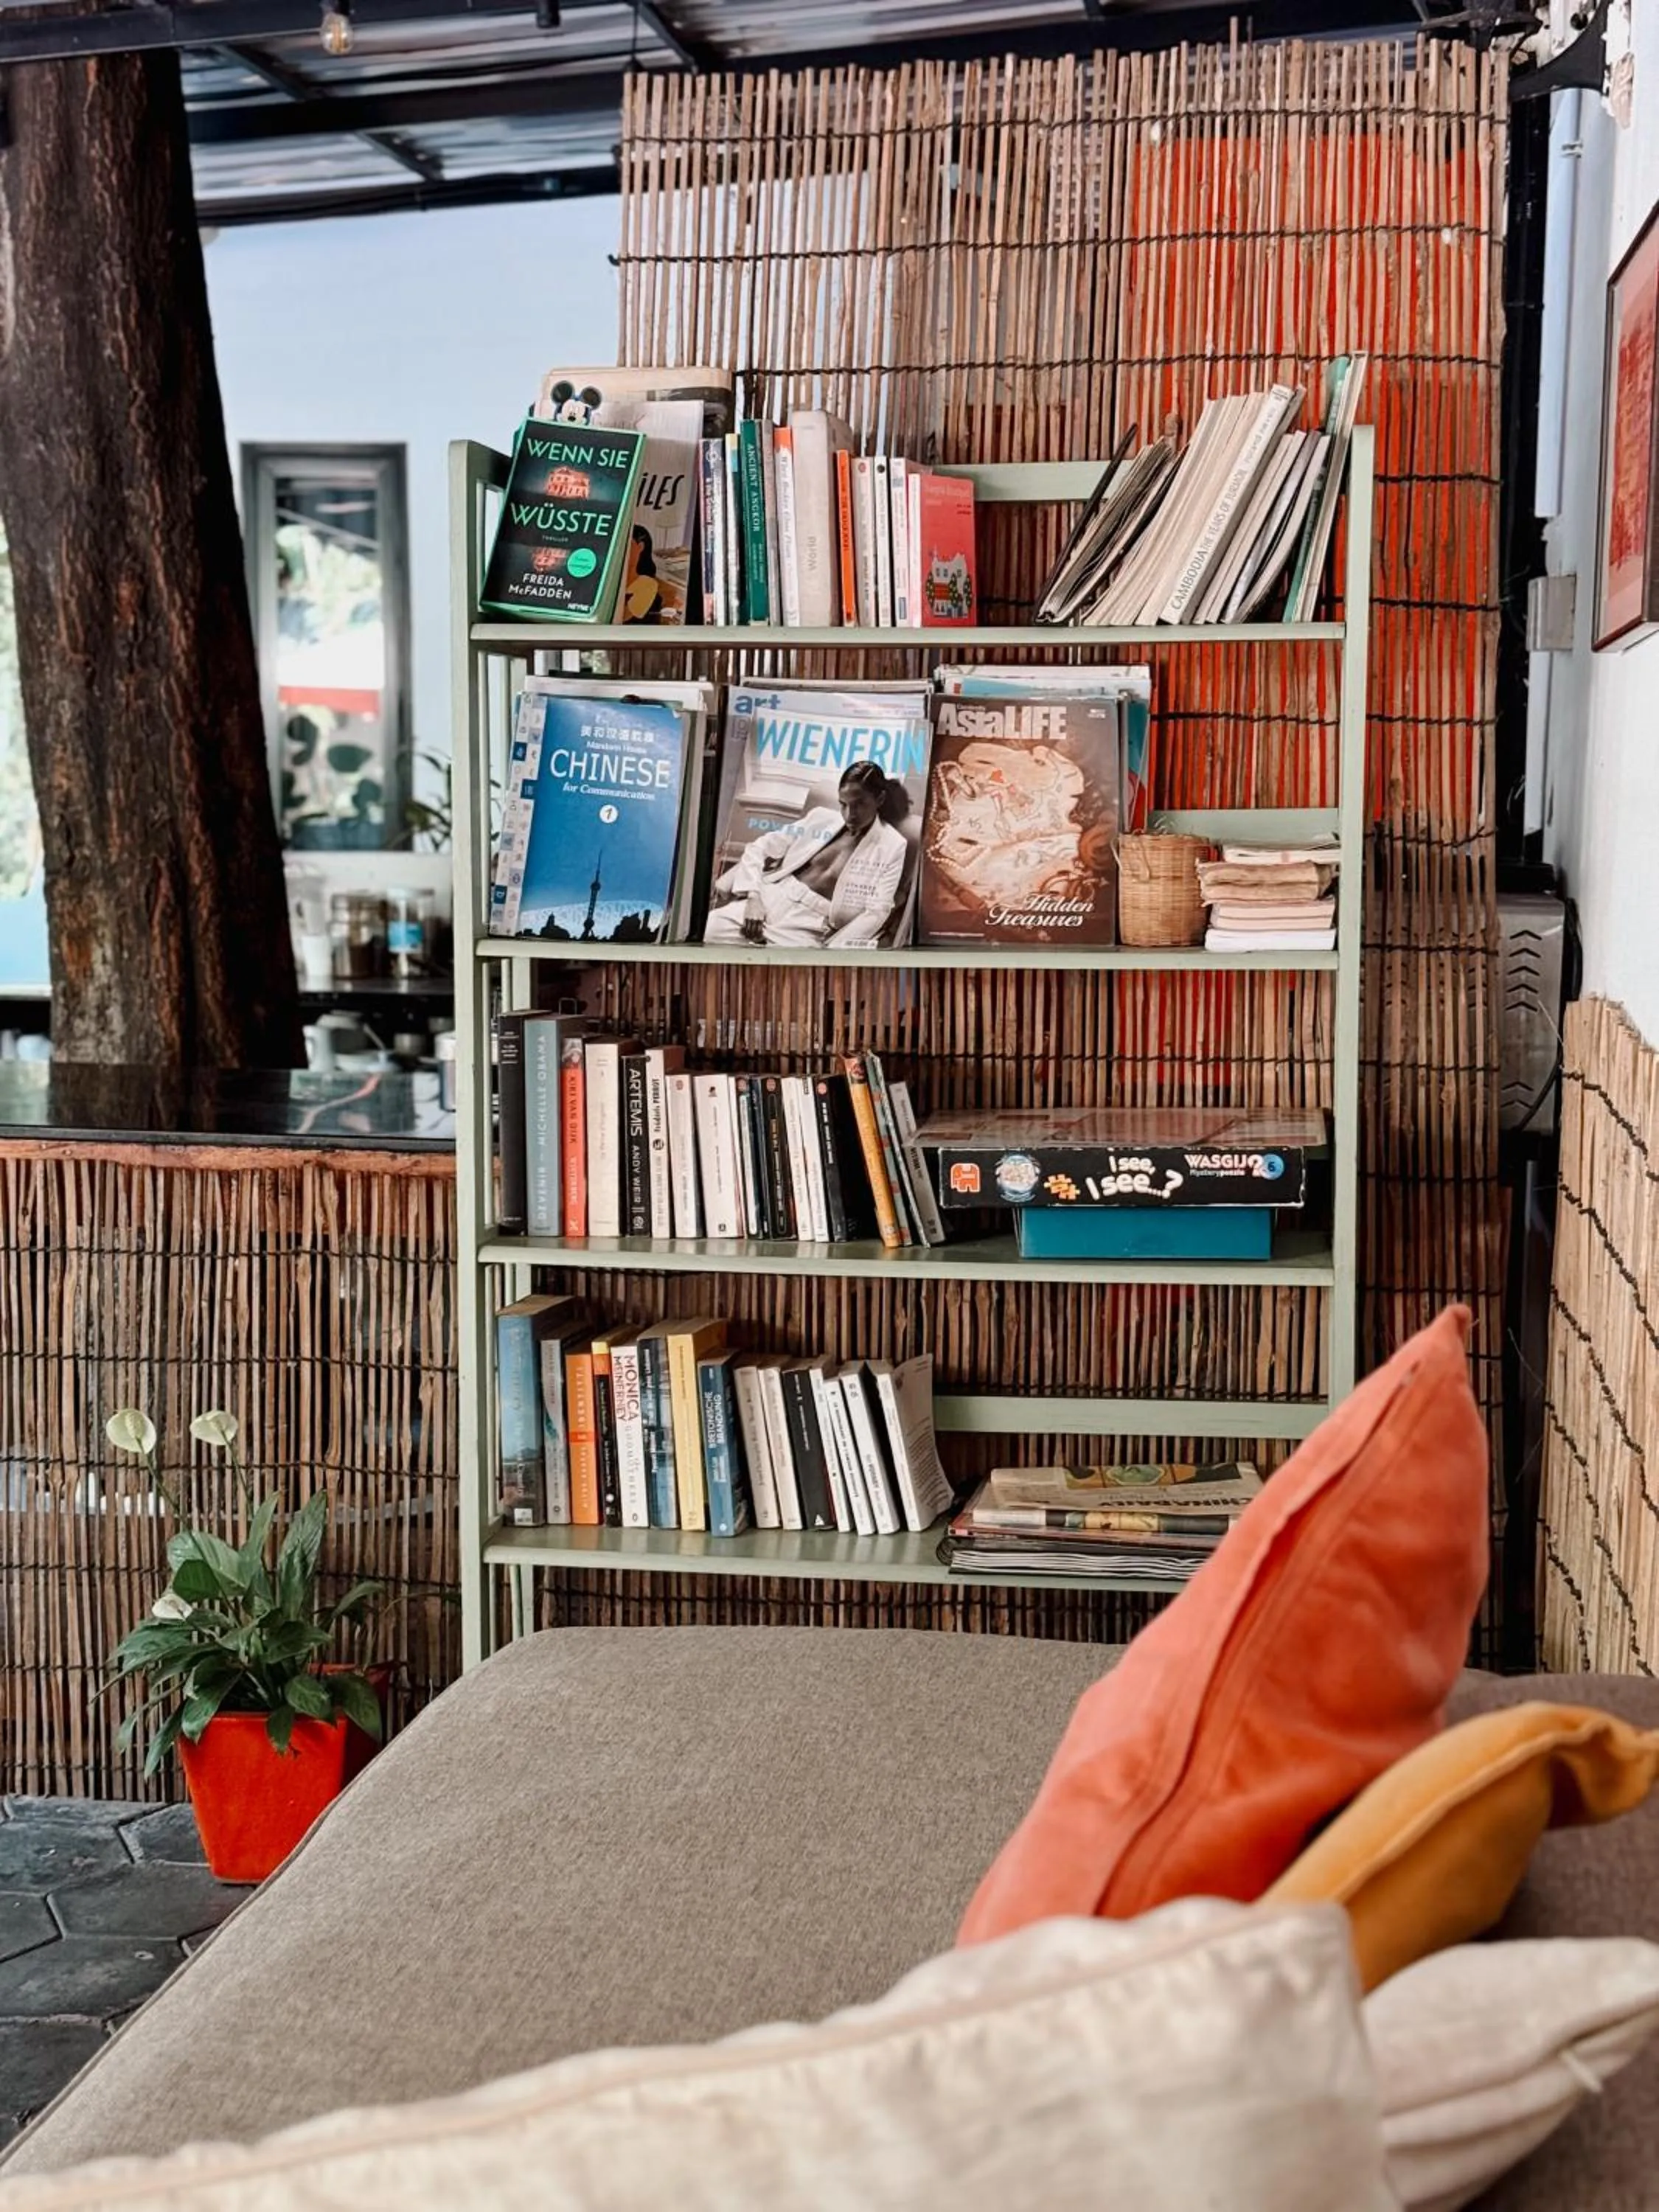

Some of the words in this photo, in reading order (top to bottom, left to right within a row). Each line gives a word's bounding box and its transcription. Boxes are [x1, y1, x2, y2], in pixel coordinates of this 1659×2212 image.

[526, 439, 593, 464] WENN
[597, 448, 630, 468] SIE
[746, 445, 758, 487] ANCIENT
[510, 502, 612, 536] WÜSSTE
[751, 490, 760, 532] ANGKOR
[508, 584, 572, 599] McFADDEN
[522, 573, 565, 587] FREIDA
[1171, 550, 1208, 611] CAMBODIA
[734, 695, 782, 714] art
[936, 703, 1067, 740] AsiaLIFE
[757, 718, 927, 774] WIENERIN
[550, 749, 671, 789] CHINESE
[563, 782, 580, 793] for
[580, 784, 655, 801] Communication
[748, 817, 805, 836] POWER
[812, 828, 833, 842] UP
[984, 904, 1084, 929] Treasures
[1024, 893, 1095, 913] Hidden
[538, 1034, 546, 1080] OBAMA
[537, 1087, 546, 1147] MICHELLE
[629, 1068, 644, 1137] ARTEMIS
[633, 1145, 641, 1173] ANDY
[1109, 1155, 1117, 1172] I
[1118, 1157, 1156, 1175] see,
[1267, 1161, 1276, 1172] 6
[537, 1166, 546, 1220] DEVENIR
[633, 1175, 641, 1204] WEIR
[1085, 1178, 1099, 1200] I
[625, 1354, 640, 1422] MONICA
[714, 1394, 725, 1444] BRANDUNG
